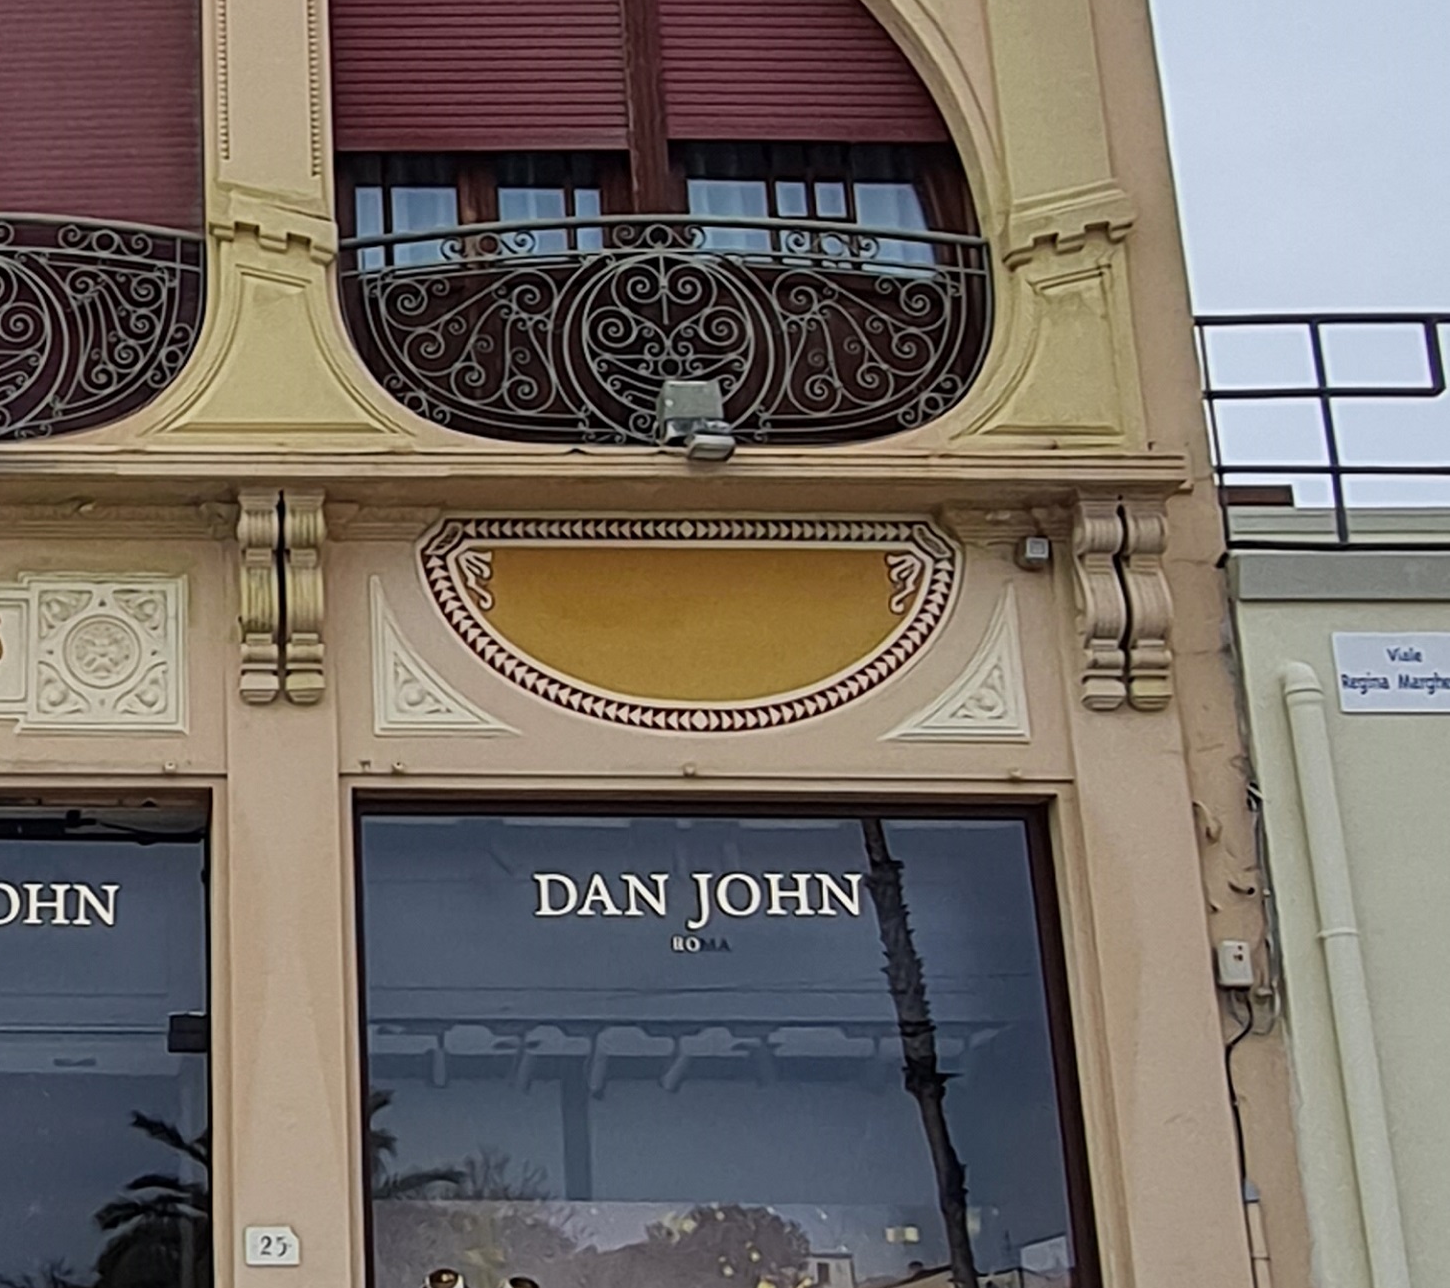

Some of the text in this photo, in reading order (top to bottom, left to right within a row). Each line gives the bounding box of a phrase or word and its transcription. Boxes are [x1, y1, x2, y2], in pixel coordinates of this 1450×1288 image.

[1386, 647, 1423, 663] Viale
[1341, 672, 1390, 695] Regina
[533, 872, 863, 930] DAN JOHN
[671, 935, 732, 953] ROMA
[260, 1235, 287, 1257] 25
